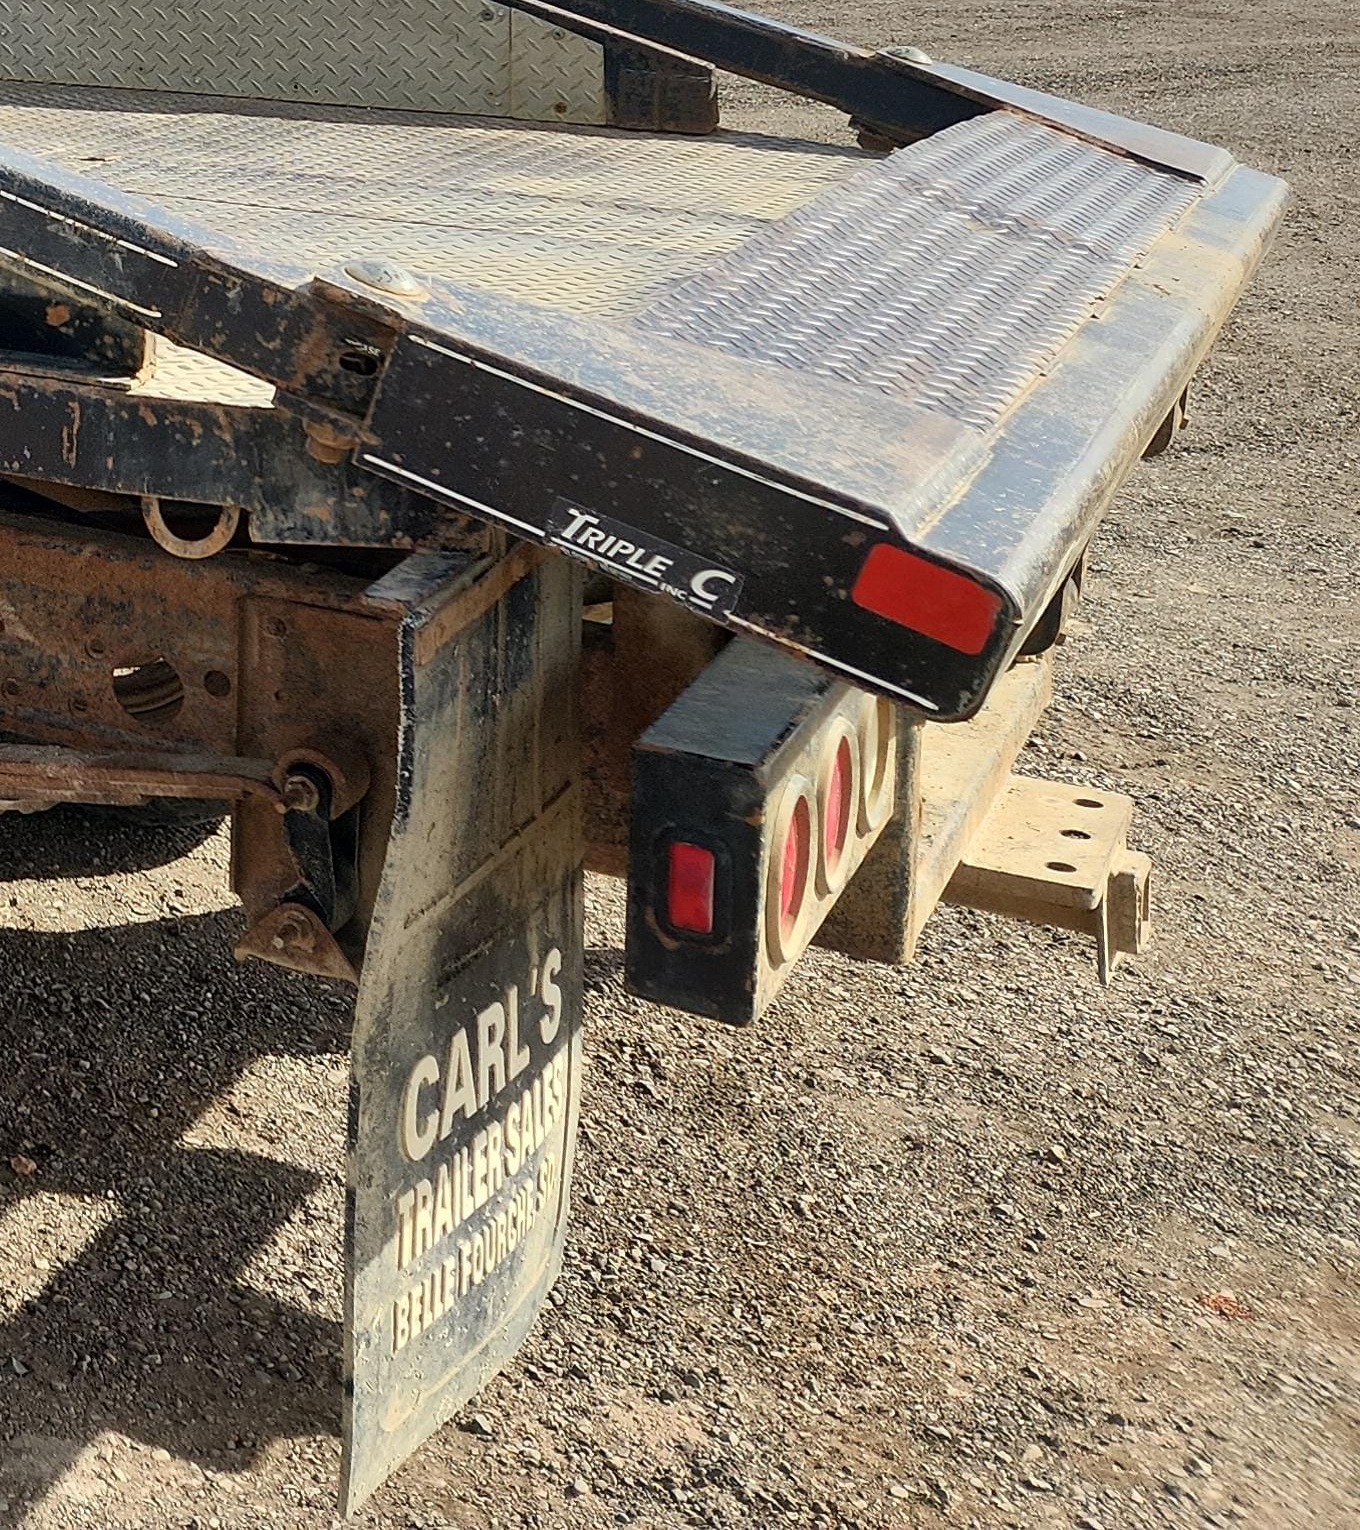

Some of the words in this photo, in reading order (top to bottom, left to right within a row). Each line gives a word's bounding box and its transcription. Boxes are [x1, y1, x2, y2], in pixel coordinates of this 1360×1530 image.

[560, 507, 675, 578] TRIPLE
[689, 569, 737, 602] C
[399, 947, 563, 1162] CARL'S
[397, 1120, 503, 1271] TRAILER
[503, 1052, 565, 1176] SALES
[393, 1255, 456, 1354] BELLE
